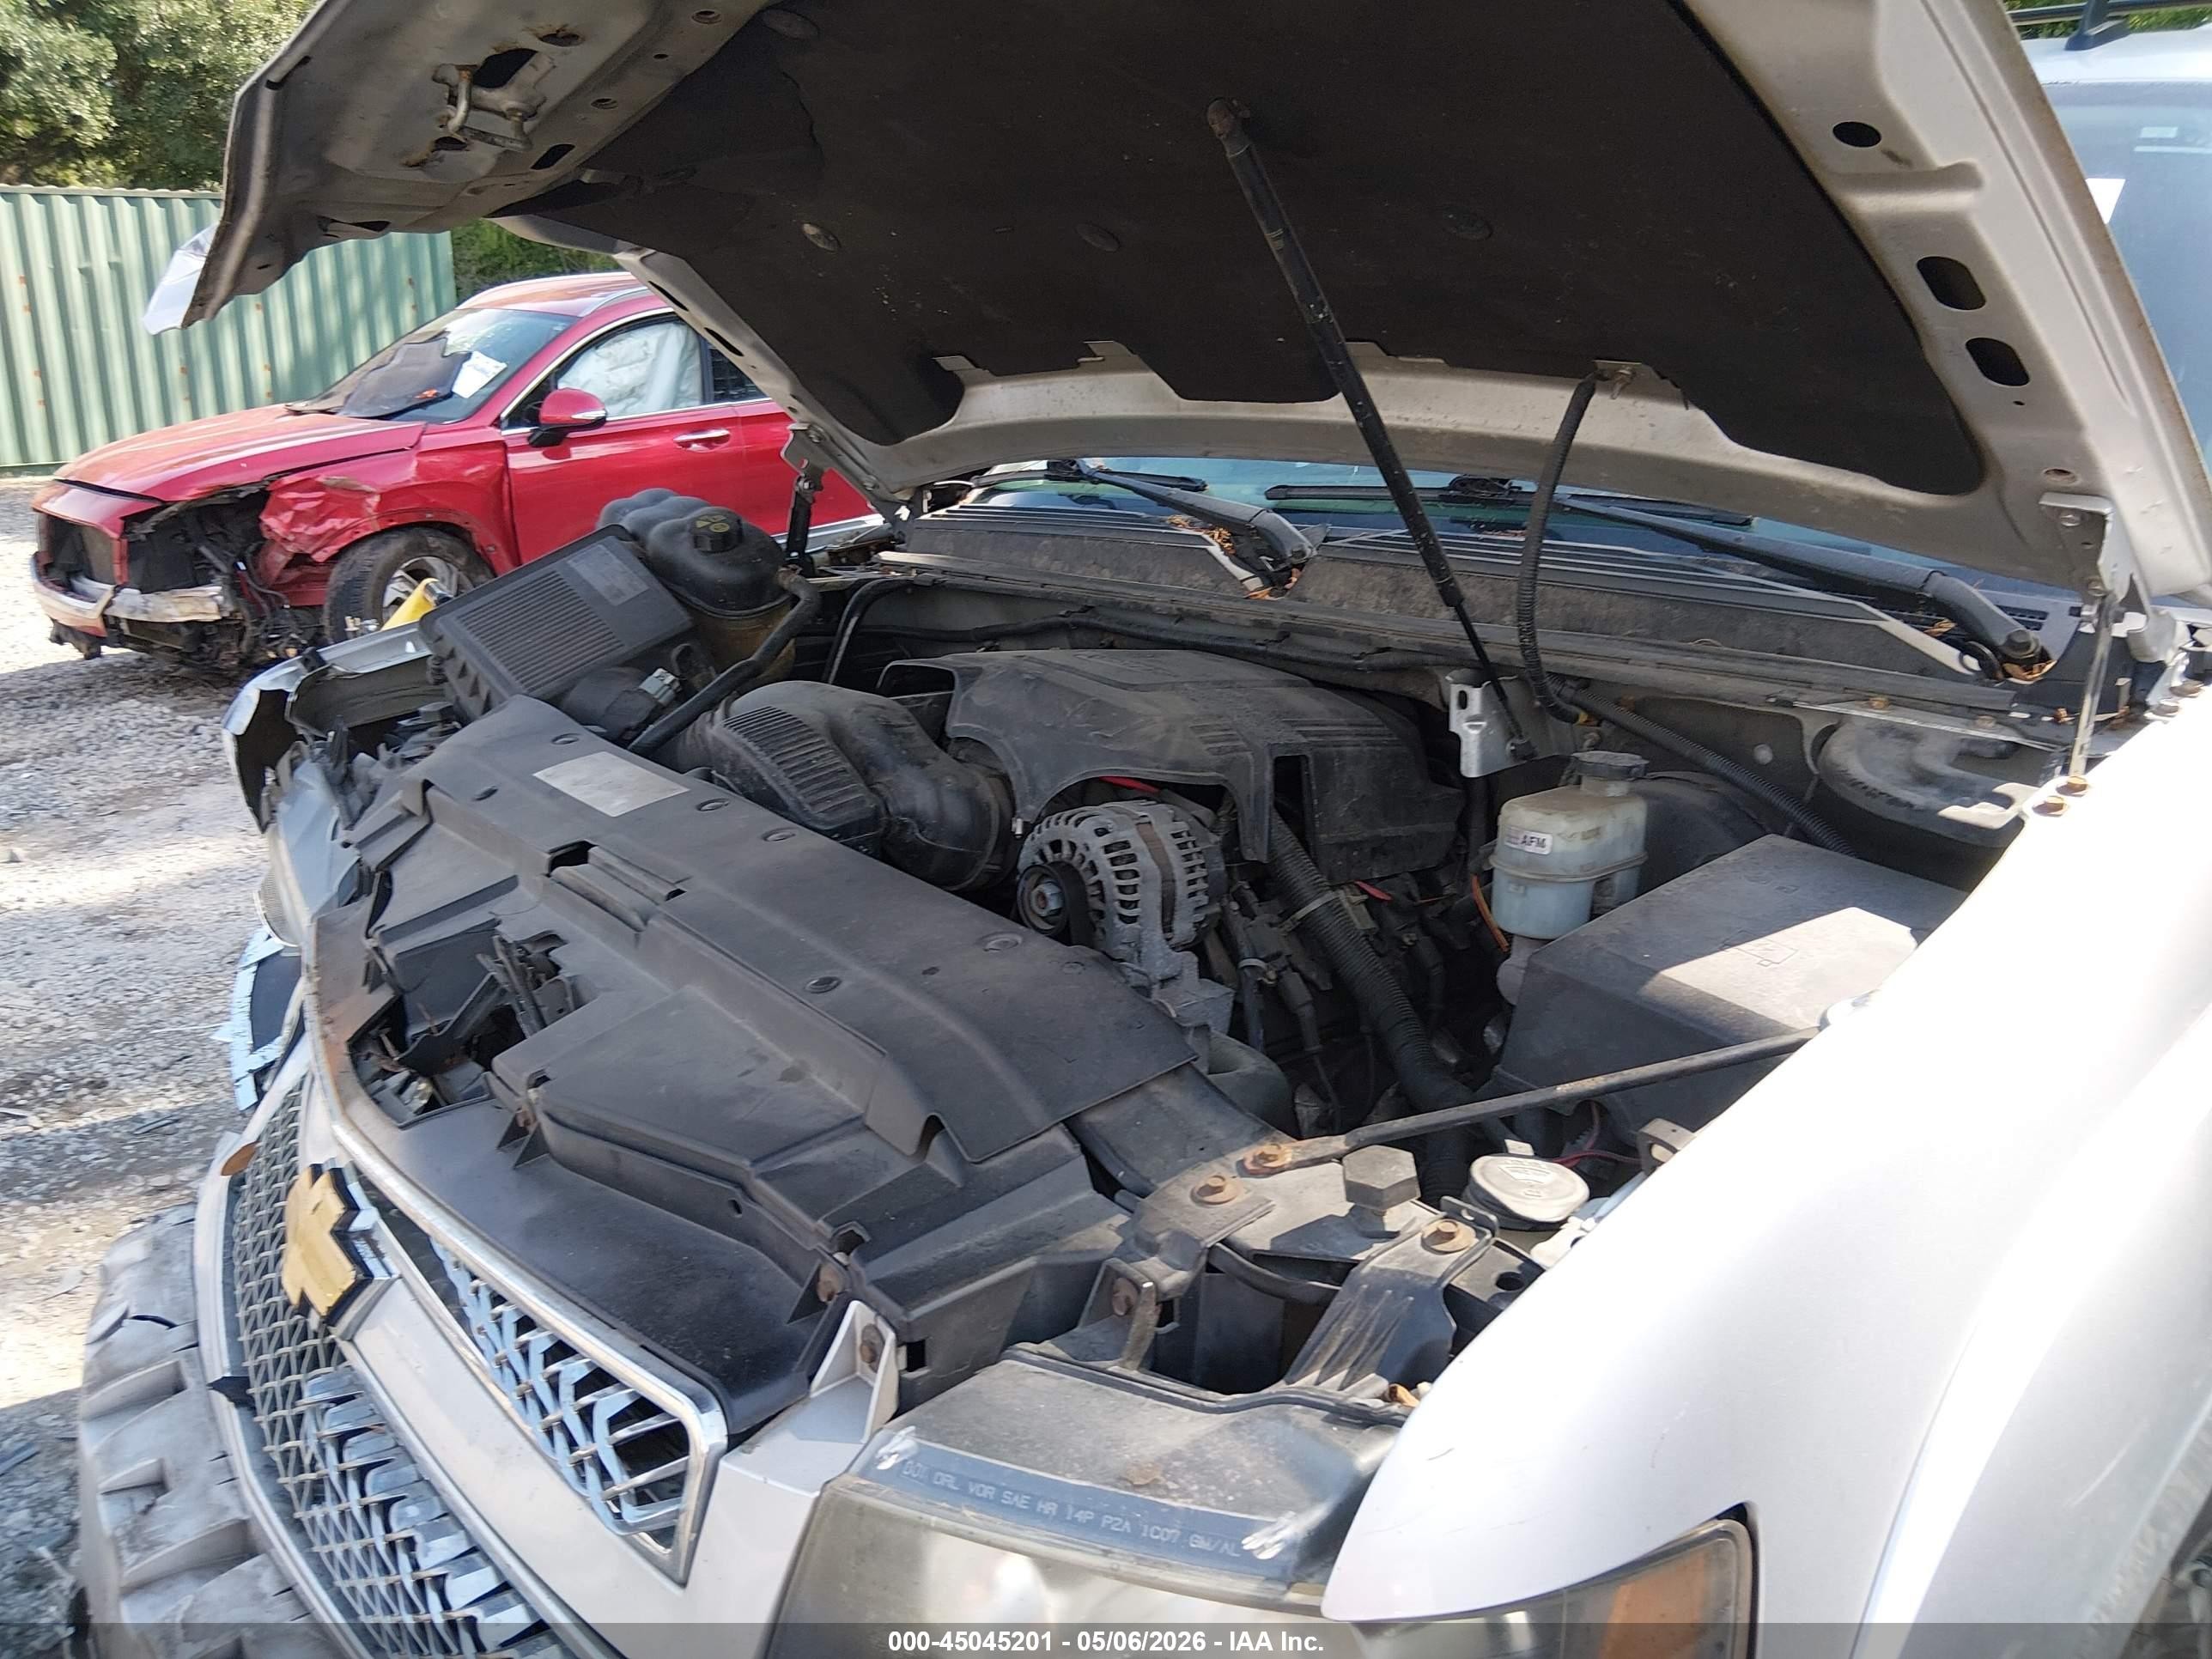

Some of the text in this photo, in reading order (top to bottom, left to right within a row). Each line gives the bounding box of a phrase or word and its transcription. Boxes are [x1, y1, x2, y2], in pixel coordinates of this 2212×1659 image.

[933, 1471, 960, 1491] DRL
[969, 1480, 996, 1500] VOR
[1001, 1490, 1030, 1510] SAE
[1036, 1498, 1058, 1517] HR
[1100, 1514, 1132, 1534] P2A
